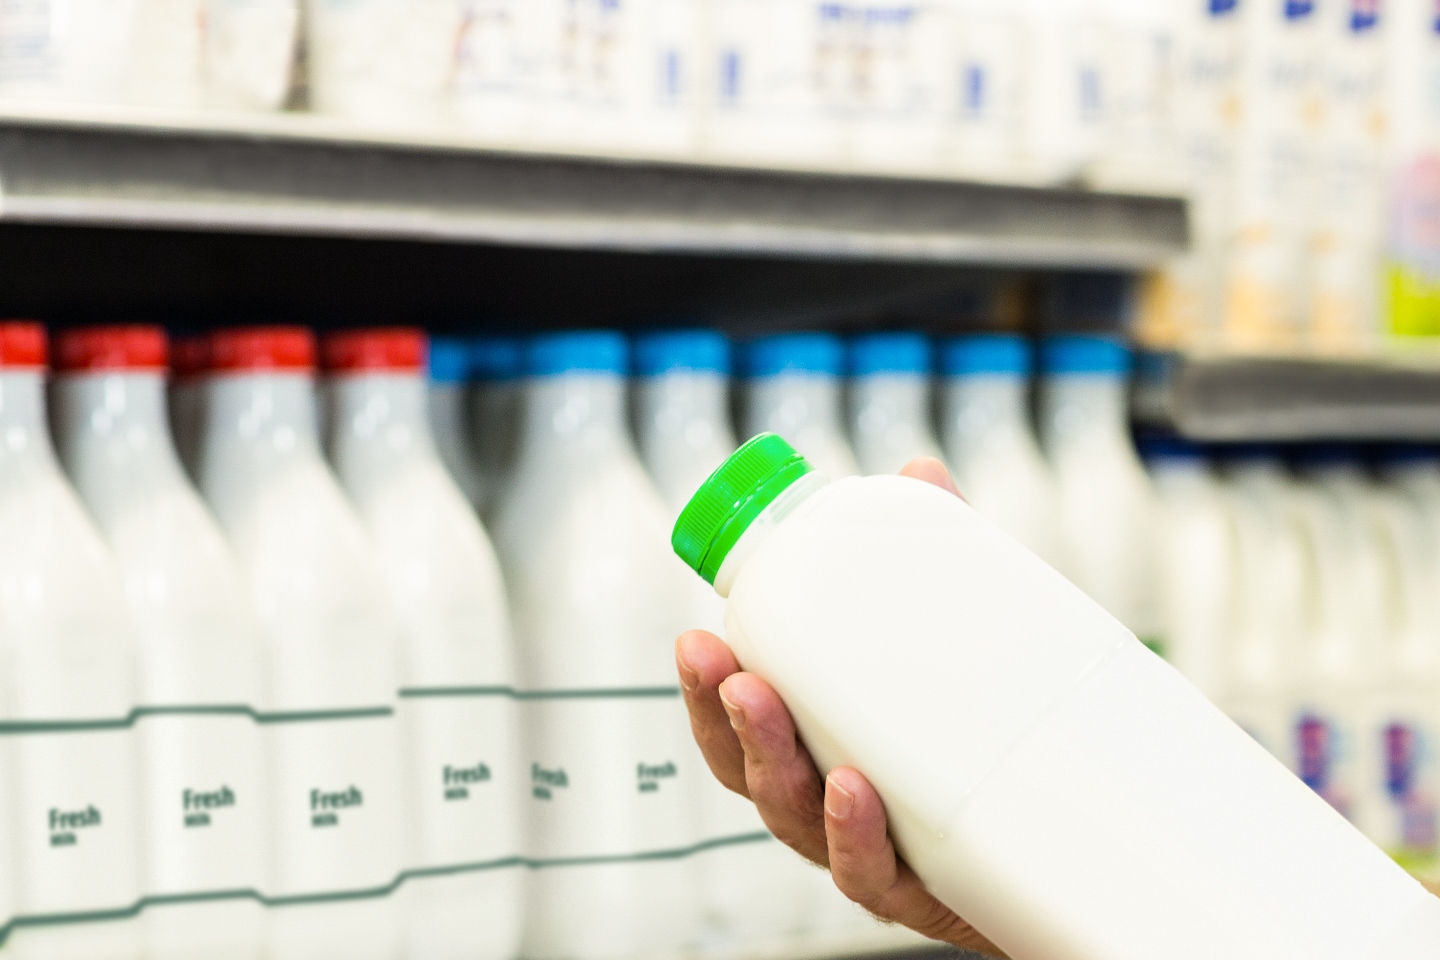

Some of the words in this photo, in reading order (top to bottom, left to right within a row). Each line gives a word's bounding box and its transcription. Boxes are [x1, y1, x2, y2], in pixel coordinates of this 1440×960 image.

[443, 762, 492, 786] Fresh
[637, 760, 678, 782] Fresh
[183, 785, 236, 811] Fresh
[309, 785, 364, 811] Fresh
[49, 804, 102, 831] Fresh
